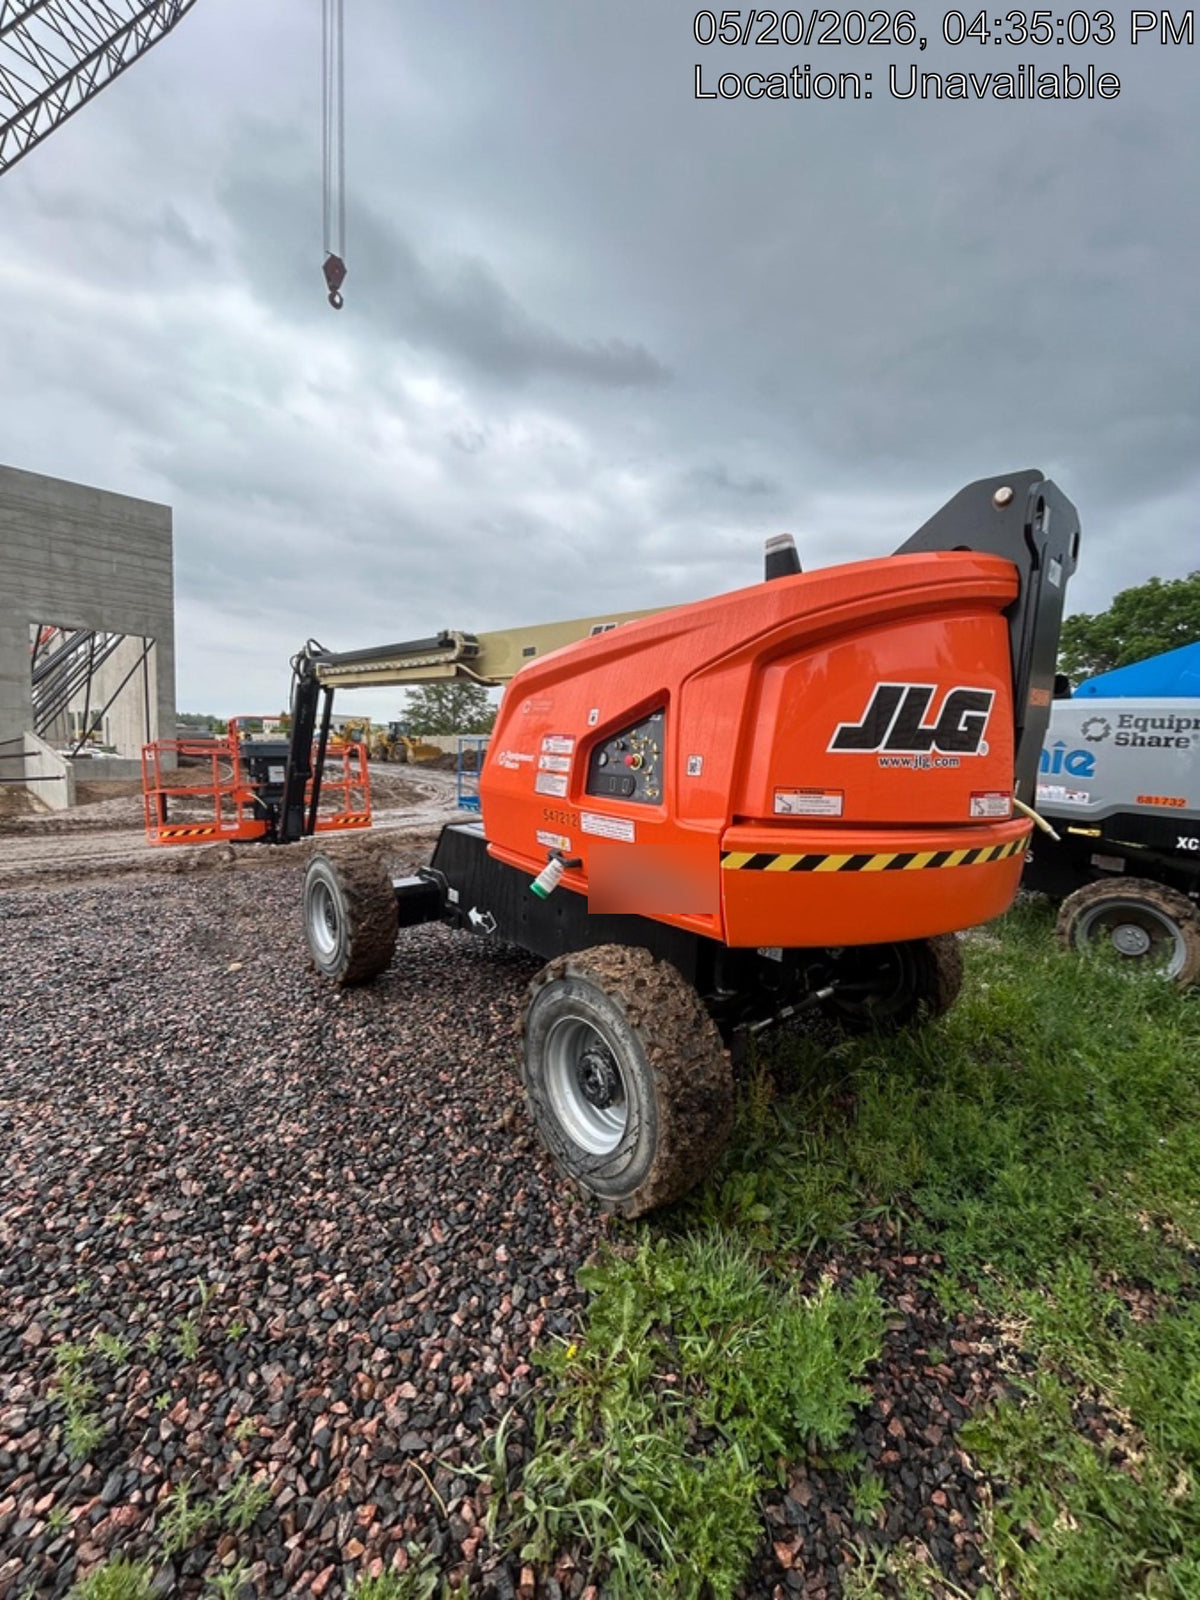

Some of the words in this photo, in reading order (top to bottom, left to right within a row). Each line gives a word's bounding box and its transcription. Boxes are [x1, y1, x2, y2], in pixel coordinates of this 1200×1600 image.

[826, 682, 996, 756] JLG
[1114, 731, 1190, 749] Share
[878, 755, 960, 769] www.jlg.com
[1176, 836, 1200, 851] XC
